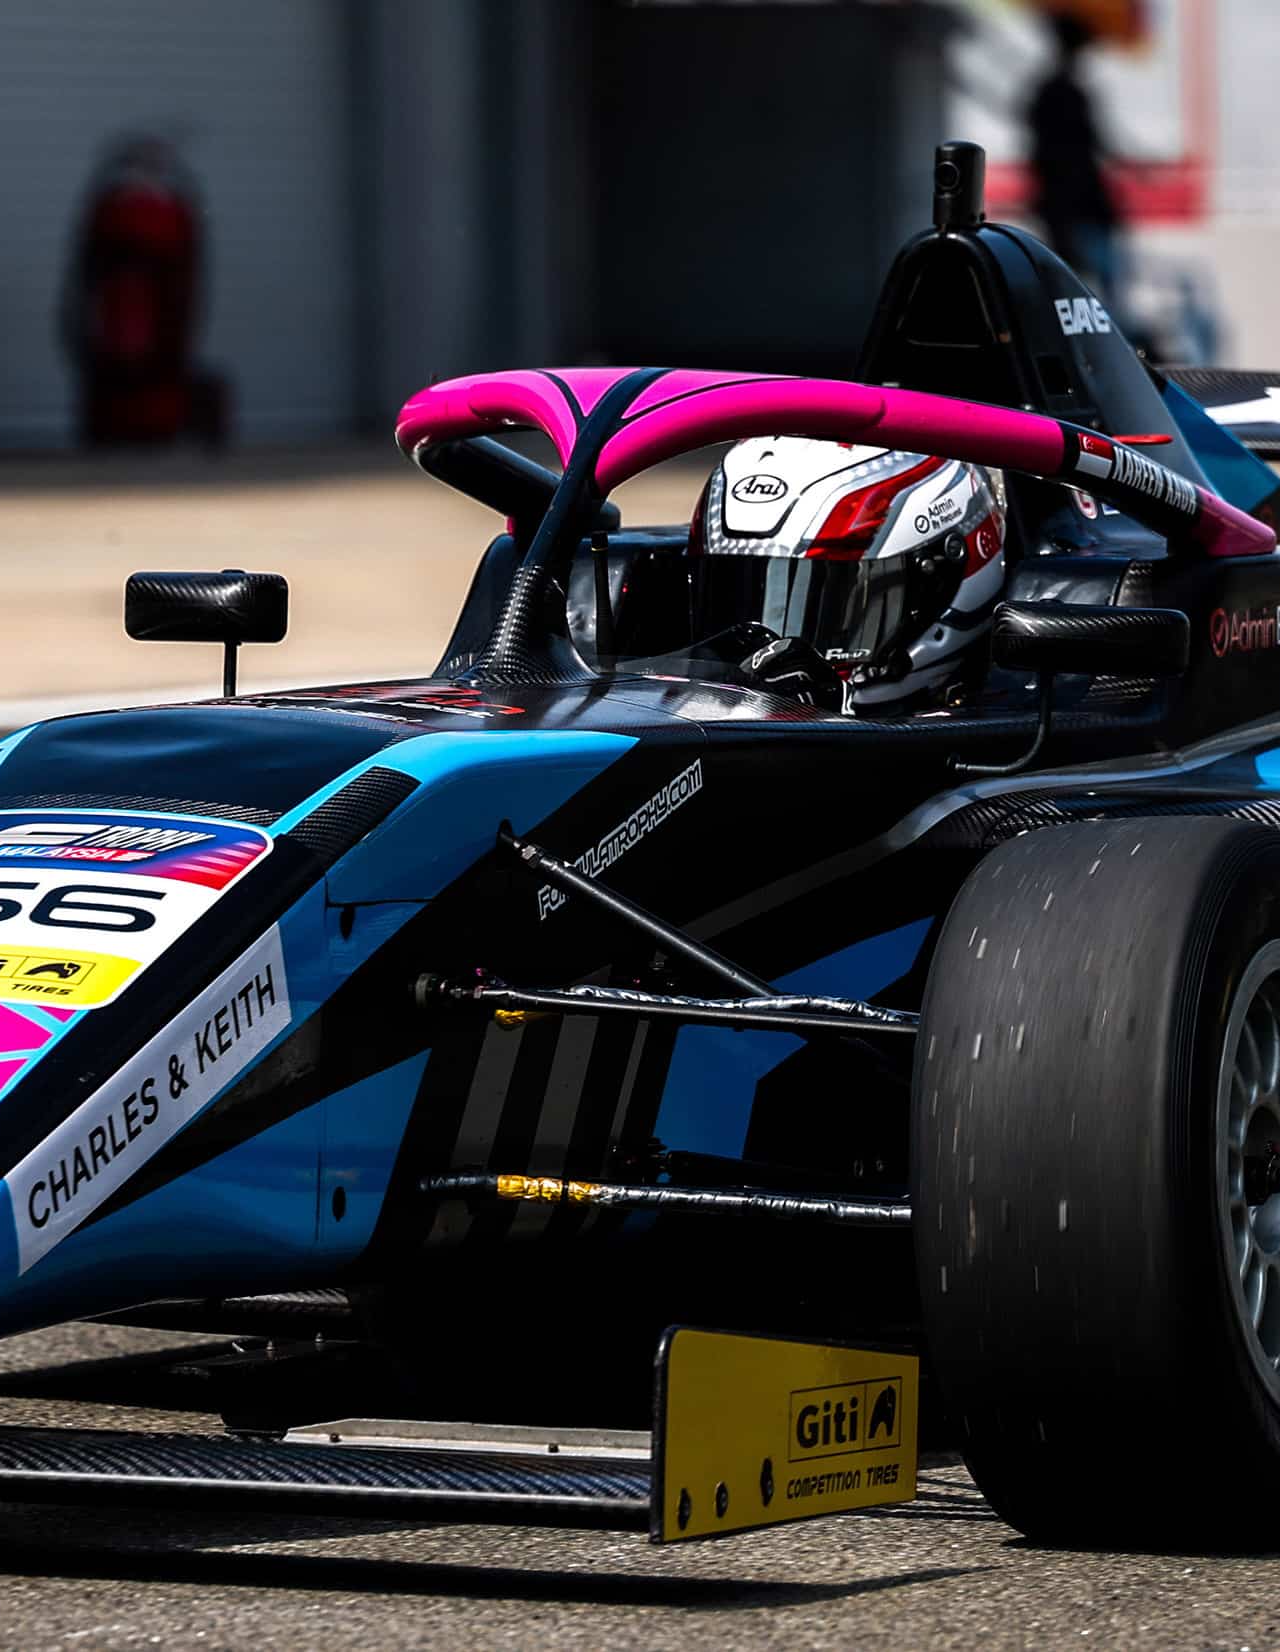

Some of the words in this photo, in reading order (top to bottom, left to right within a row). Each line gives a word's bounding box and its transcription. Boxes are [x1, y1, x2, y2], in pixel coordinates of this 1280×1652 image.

[741, 475, 783, 496] Arai
[928, 498, 955, 518] Admin
[12, 983, 73, 996] TIRES
[28, 1077, 159, 1229] CHARLES
[168, 1054, 190, 1100] &
[194, 963, 276, 1074] KEITH
[797, 1397, 859, 1449] Giti
[786, 1470, 861, 1500] COMPETITION
[866, 1464, 900, 1488] TIRES
